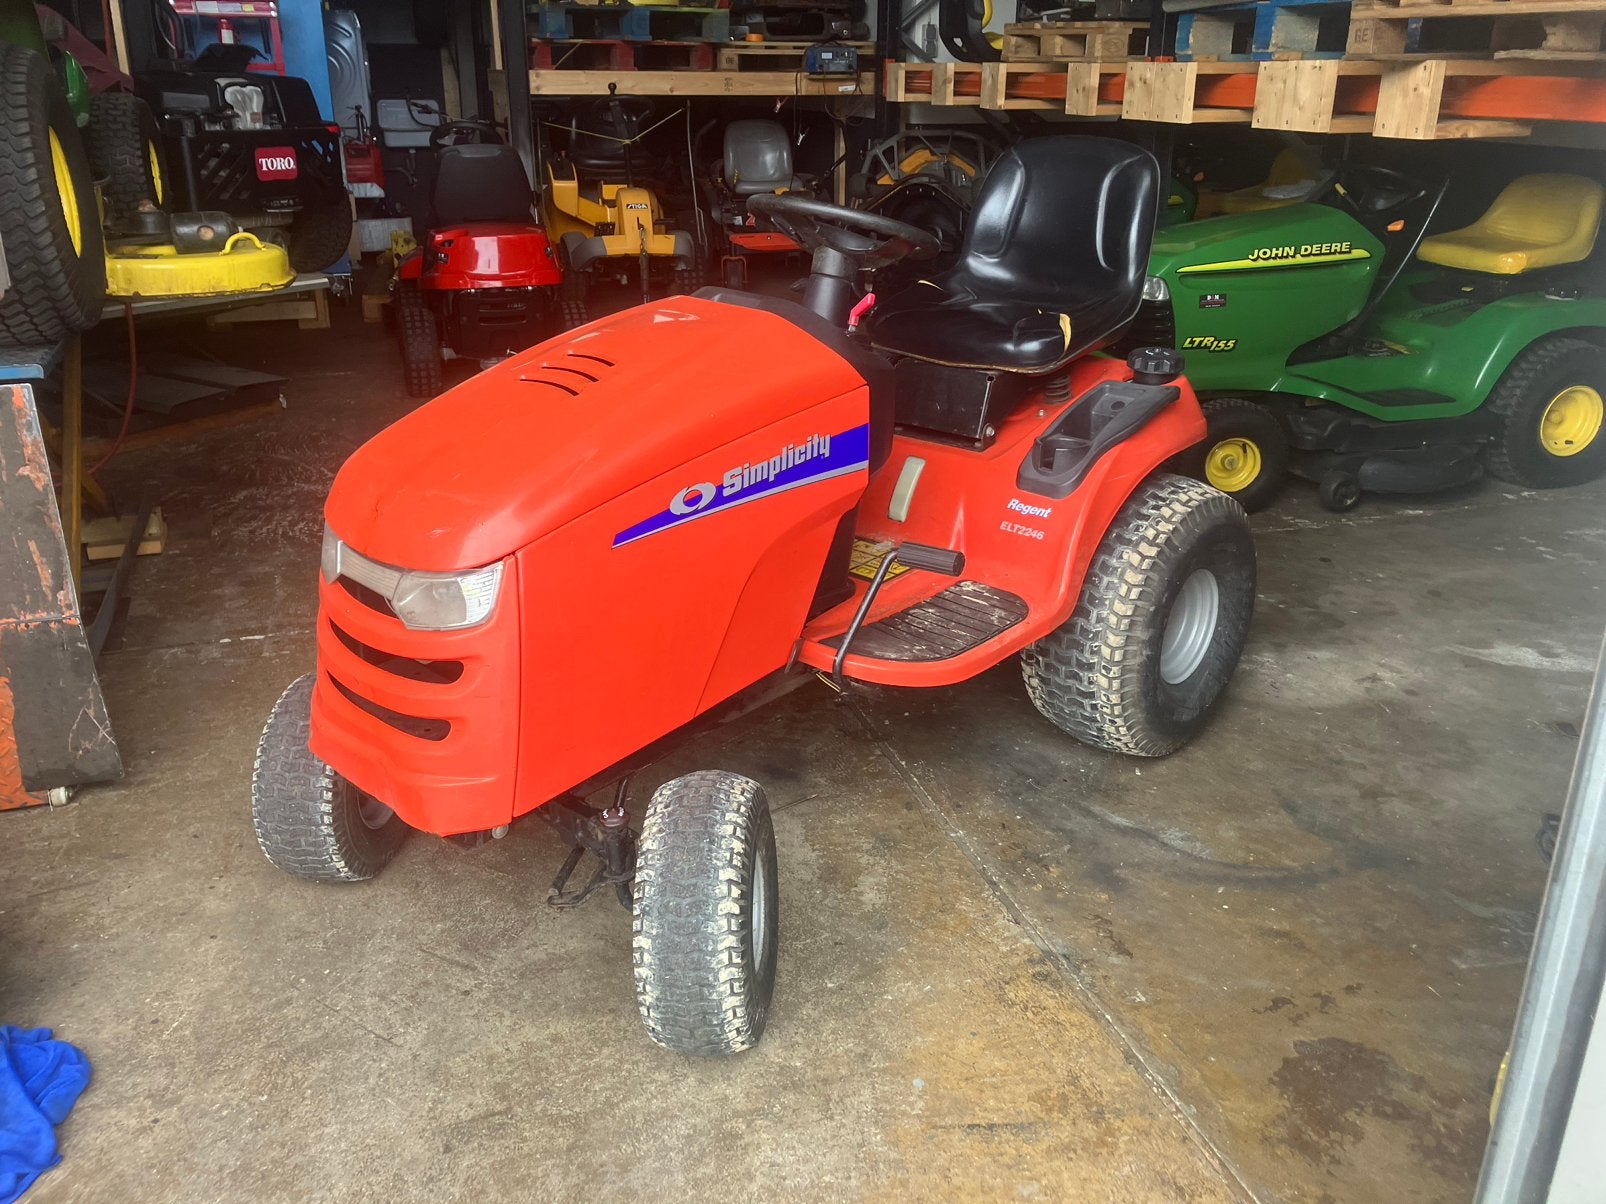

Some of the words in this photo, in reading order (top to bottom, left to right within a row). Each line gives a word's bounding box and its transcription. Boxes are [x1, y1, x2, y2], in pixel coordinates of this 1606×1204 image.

[258, 156, 295, 171] TORO
[1248, 246, 1297, 261] JOHN
[1300, 242, 1352, 256] DEERE
[722, 433, 832, 497] Simplicity
[1007, 498, 1052, 518] Regent
[999, 521, 1045, 540] ELT2246
